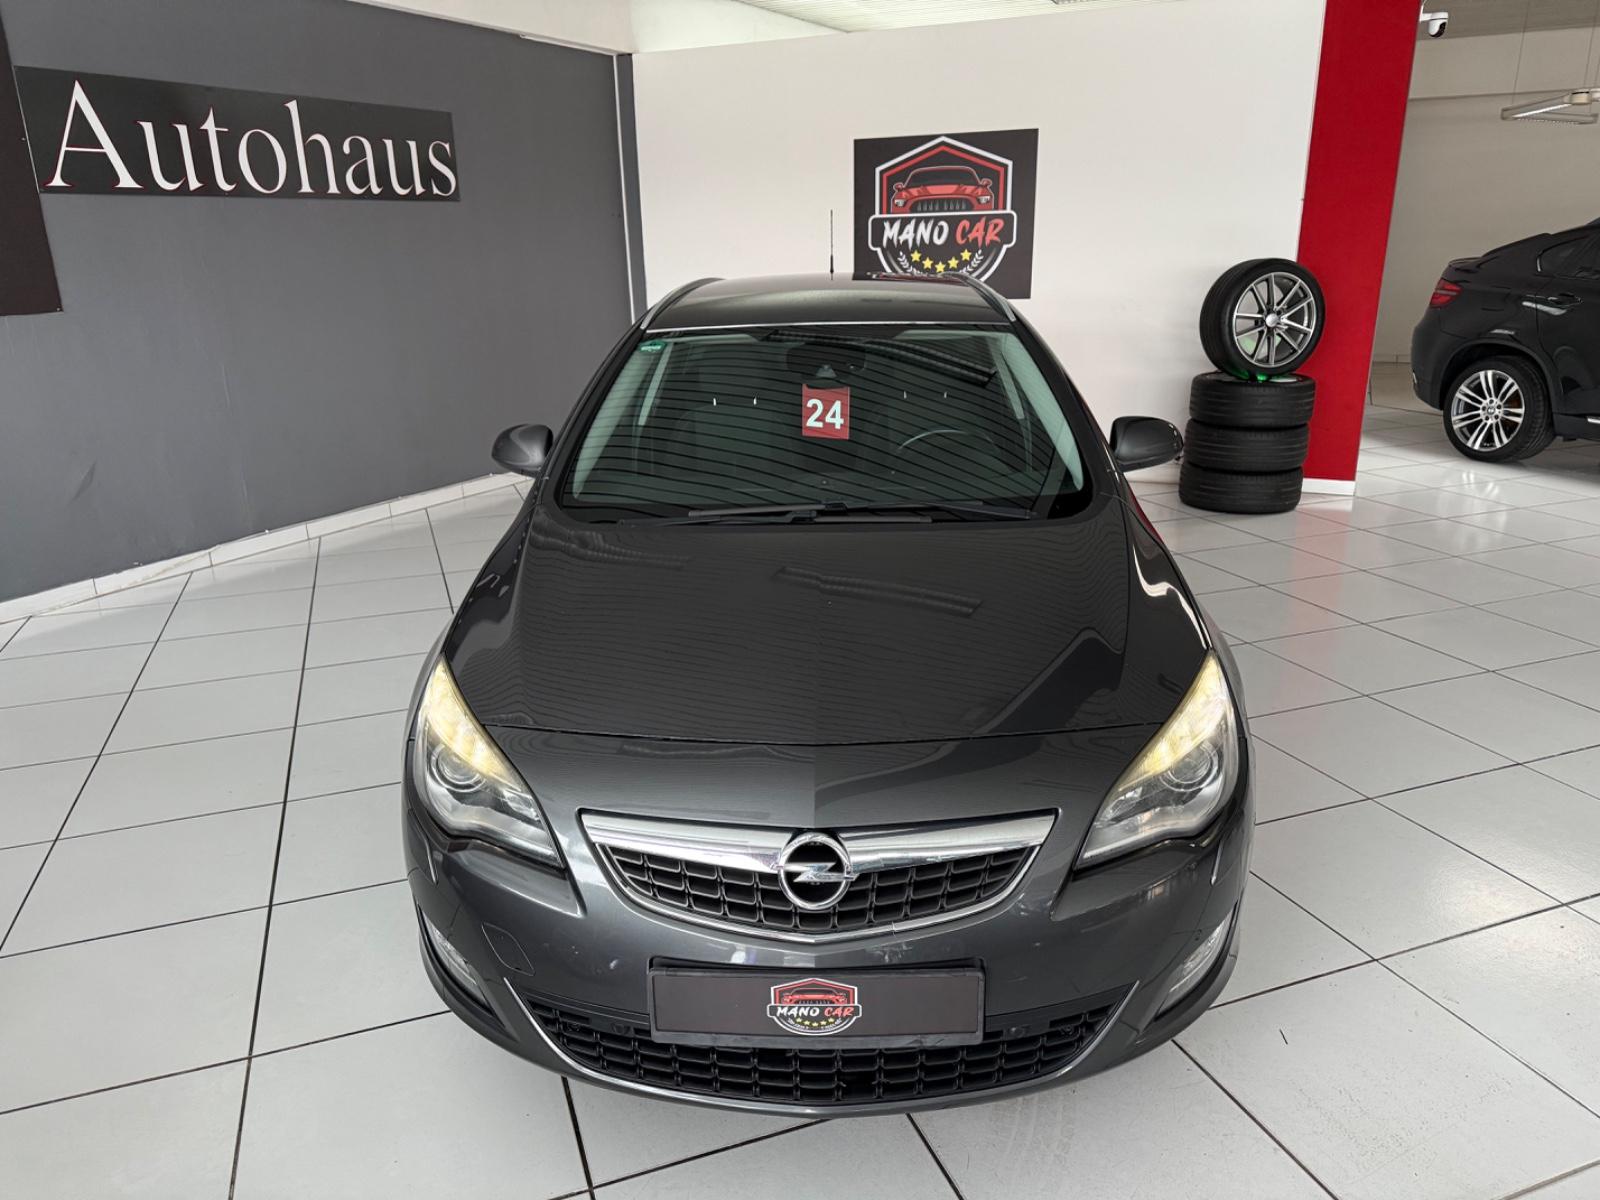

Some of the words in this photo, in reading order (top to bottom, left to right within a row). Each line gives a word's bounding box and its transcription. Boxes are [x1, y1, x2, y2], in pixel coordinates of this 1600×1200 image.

[46, 79, 458, 196] Autohaus
[882, 217, 950, 250] MANO
[956, 216, 1005, 248] CAR
[805, 398, 844, 429] 24
[776, 1006, 820, 1017] MANO
[824, 1006, 855, 1017] CAR
